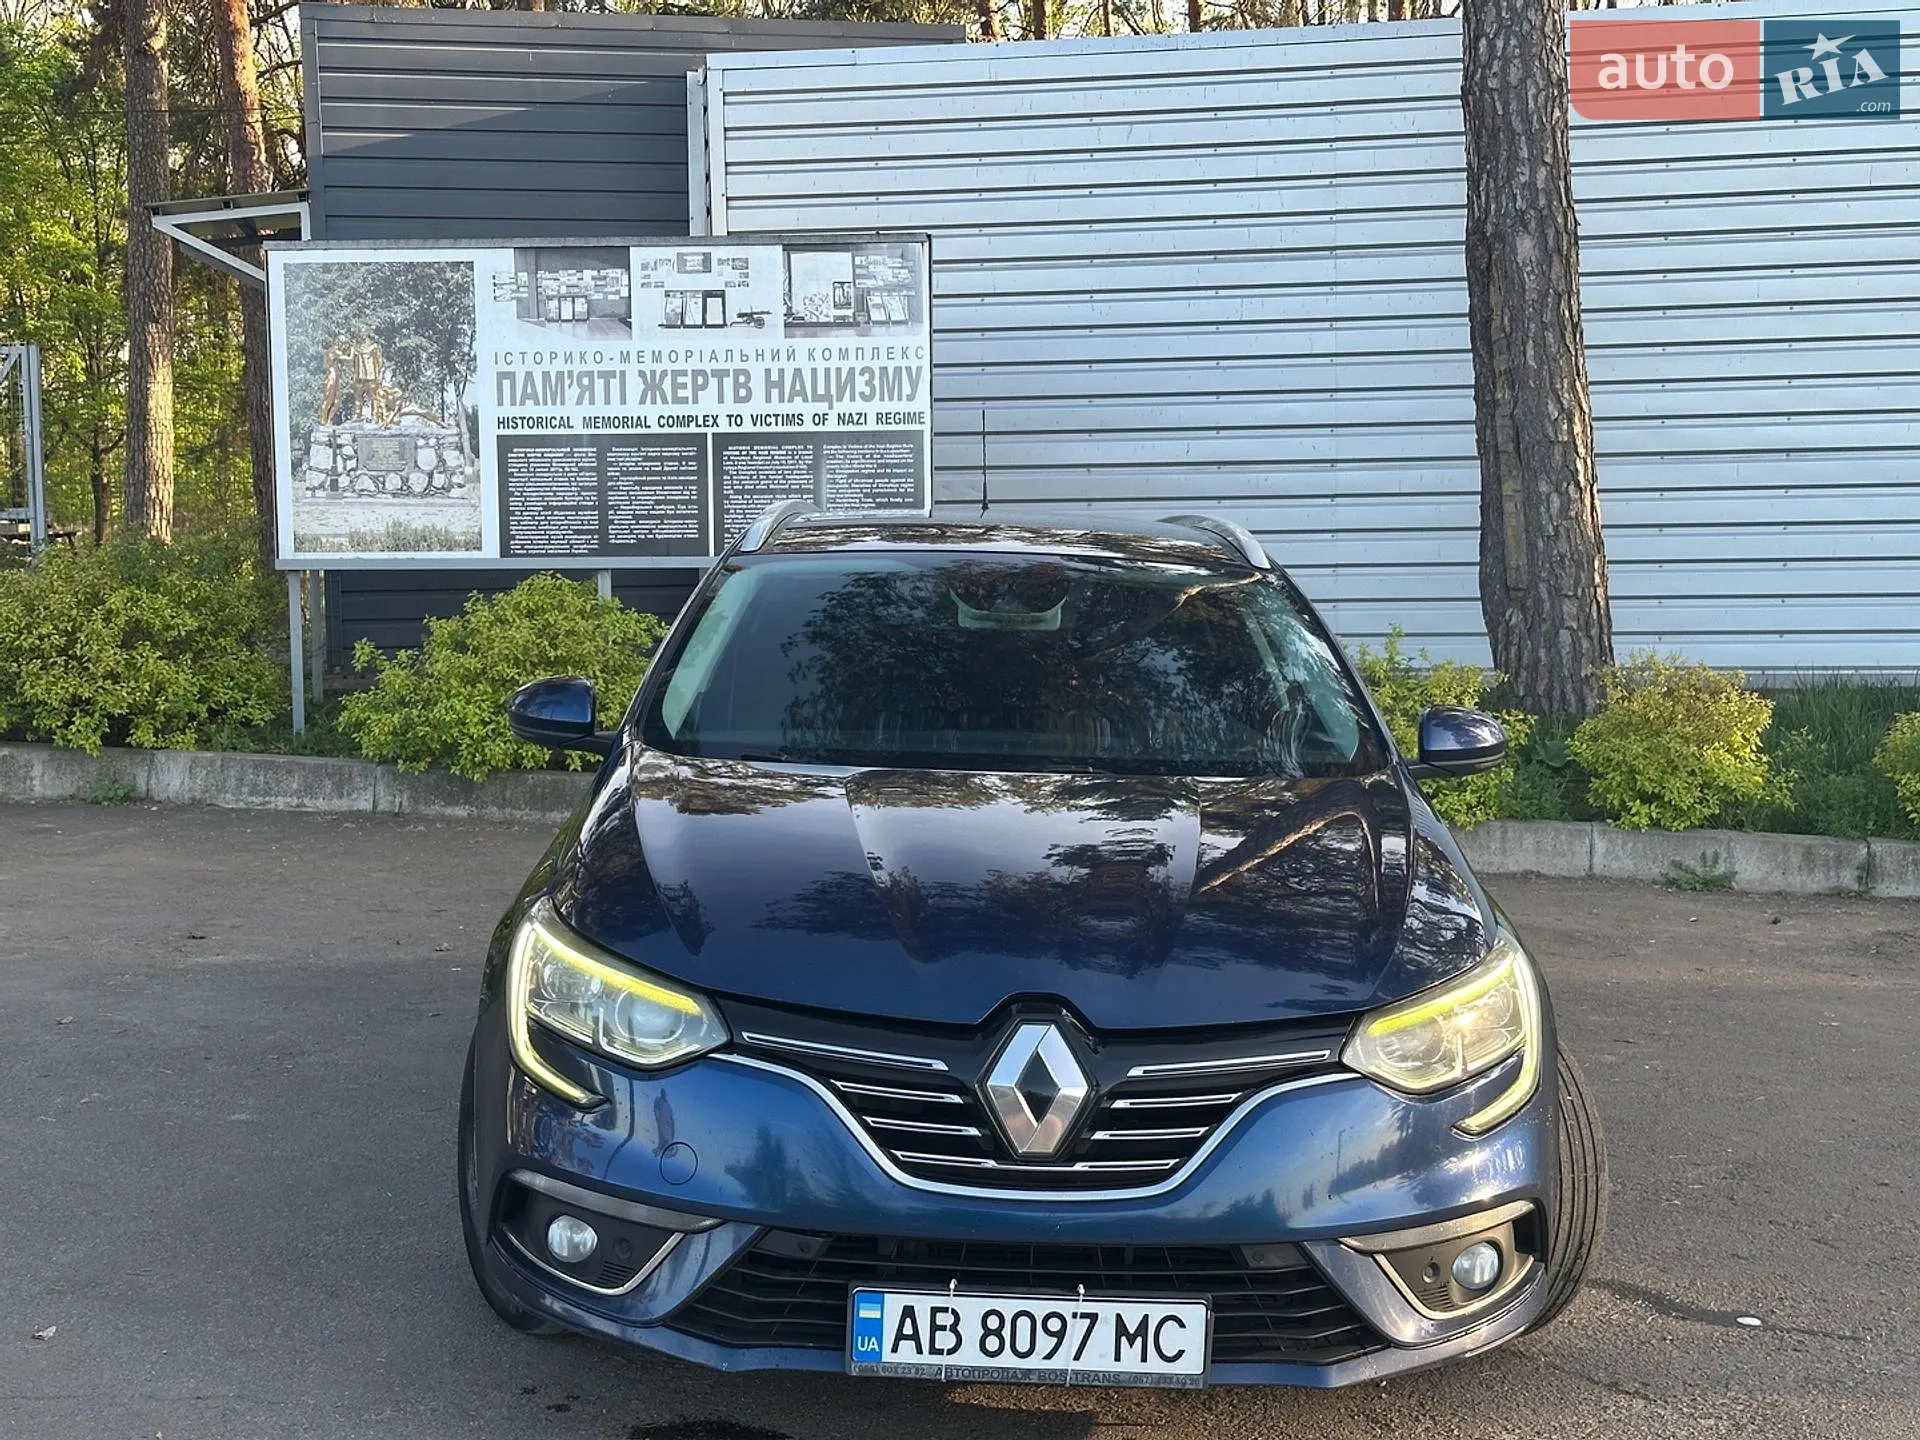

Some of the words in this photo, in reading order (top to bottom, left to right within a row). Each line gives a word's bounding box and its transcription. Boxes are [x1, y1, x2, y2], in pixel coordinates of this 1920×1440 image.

[494, 345, 796, 365] ІСТОРИКО-МЕМОРІАЛЬНИЙ
[807, 346, 925, 362] КОМПЛЕКС
[637, 368, 753, 405] ЖЕРТВ
[764, 365, 924, 411] НАЦИЗМУ
[496, 415, 574, 430] HISTORICAL
[582, 415, 651, 429] MEMORIAL
[657, 414, 719, 428] COMPLEX
[726, 414, 744, 427] TO
[750, 413, 804, 427] VICTIMS
[812, 413, 829, 427] OF
[837, 412, 868, 426] NAZI
[875, 411, 926, 426] REGIME
[857, 1335, 880, 1352] UA
[890, 1304, 963, 1356] AB
[978, 1308, 1099, 1362] 8097
[1113, 1312, 1187, 1363] MC
